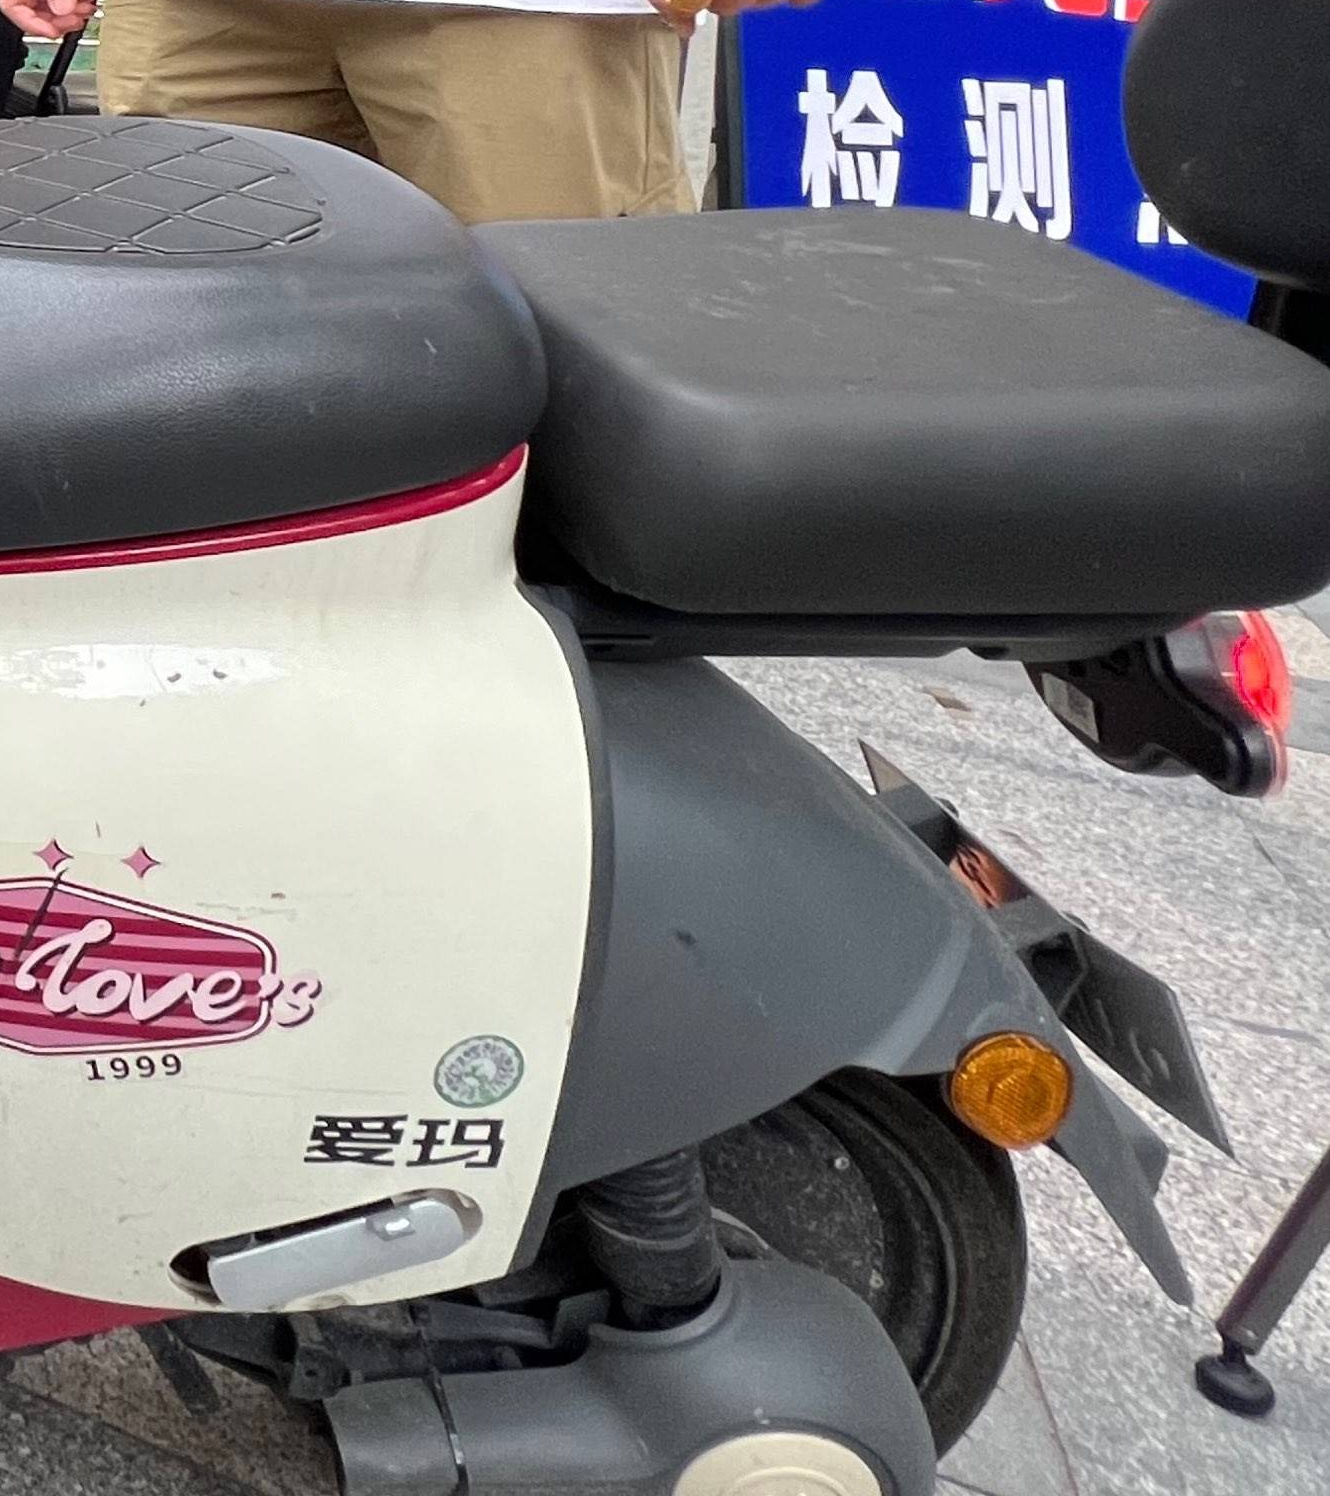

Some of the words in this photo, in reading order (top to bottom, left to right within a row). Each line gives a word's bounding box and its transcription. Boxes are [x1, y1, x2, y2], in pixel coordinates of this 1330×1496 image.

[798, 67, 1189, 242] 检测
[85, 1053, 184, 1082] 1999
[304, 1114, 505, 1169] 爱玛
